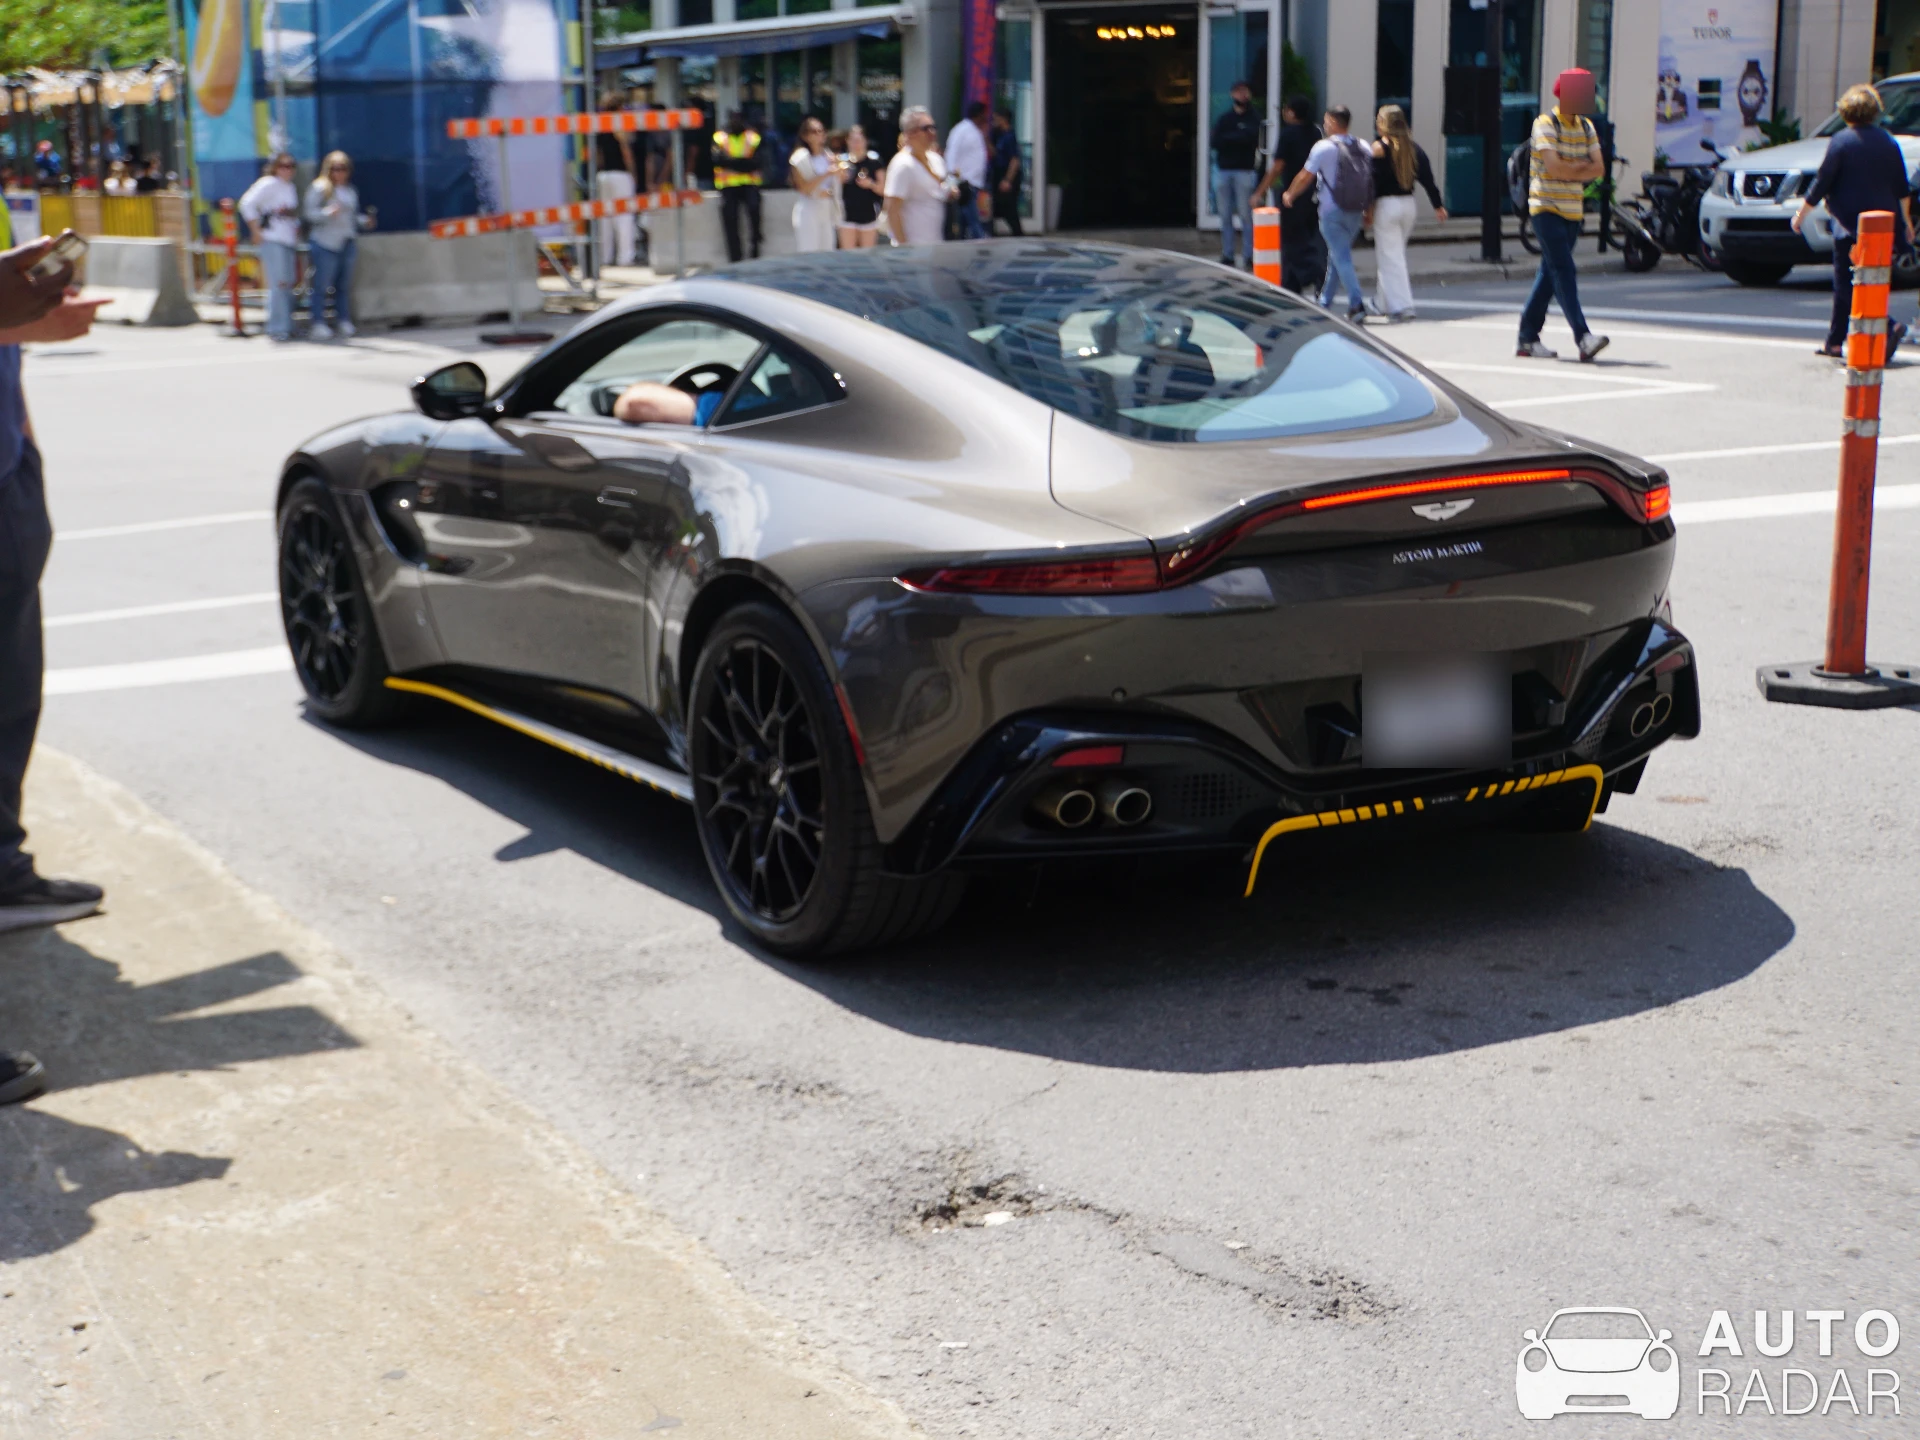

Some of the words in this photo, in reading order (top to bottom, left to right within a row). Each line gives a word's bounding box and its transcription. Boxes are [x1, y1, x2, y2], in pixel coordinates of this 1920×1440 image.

[1692, 26, 1732, 40] TUDOR
[1393, 548, 1434, 564] ASTON
[1436, 541, 1482, 559] MARTIN
